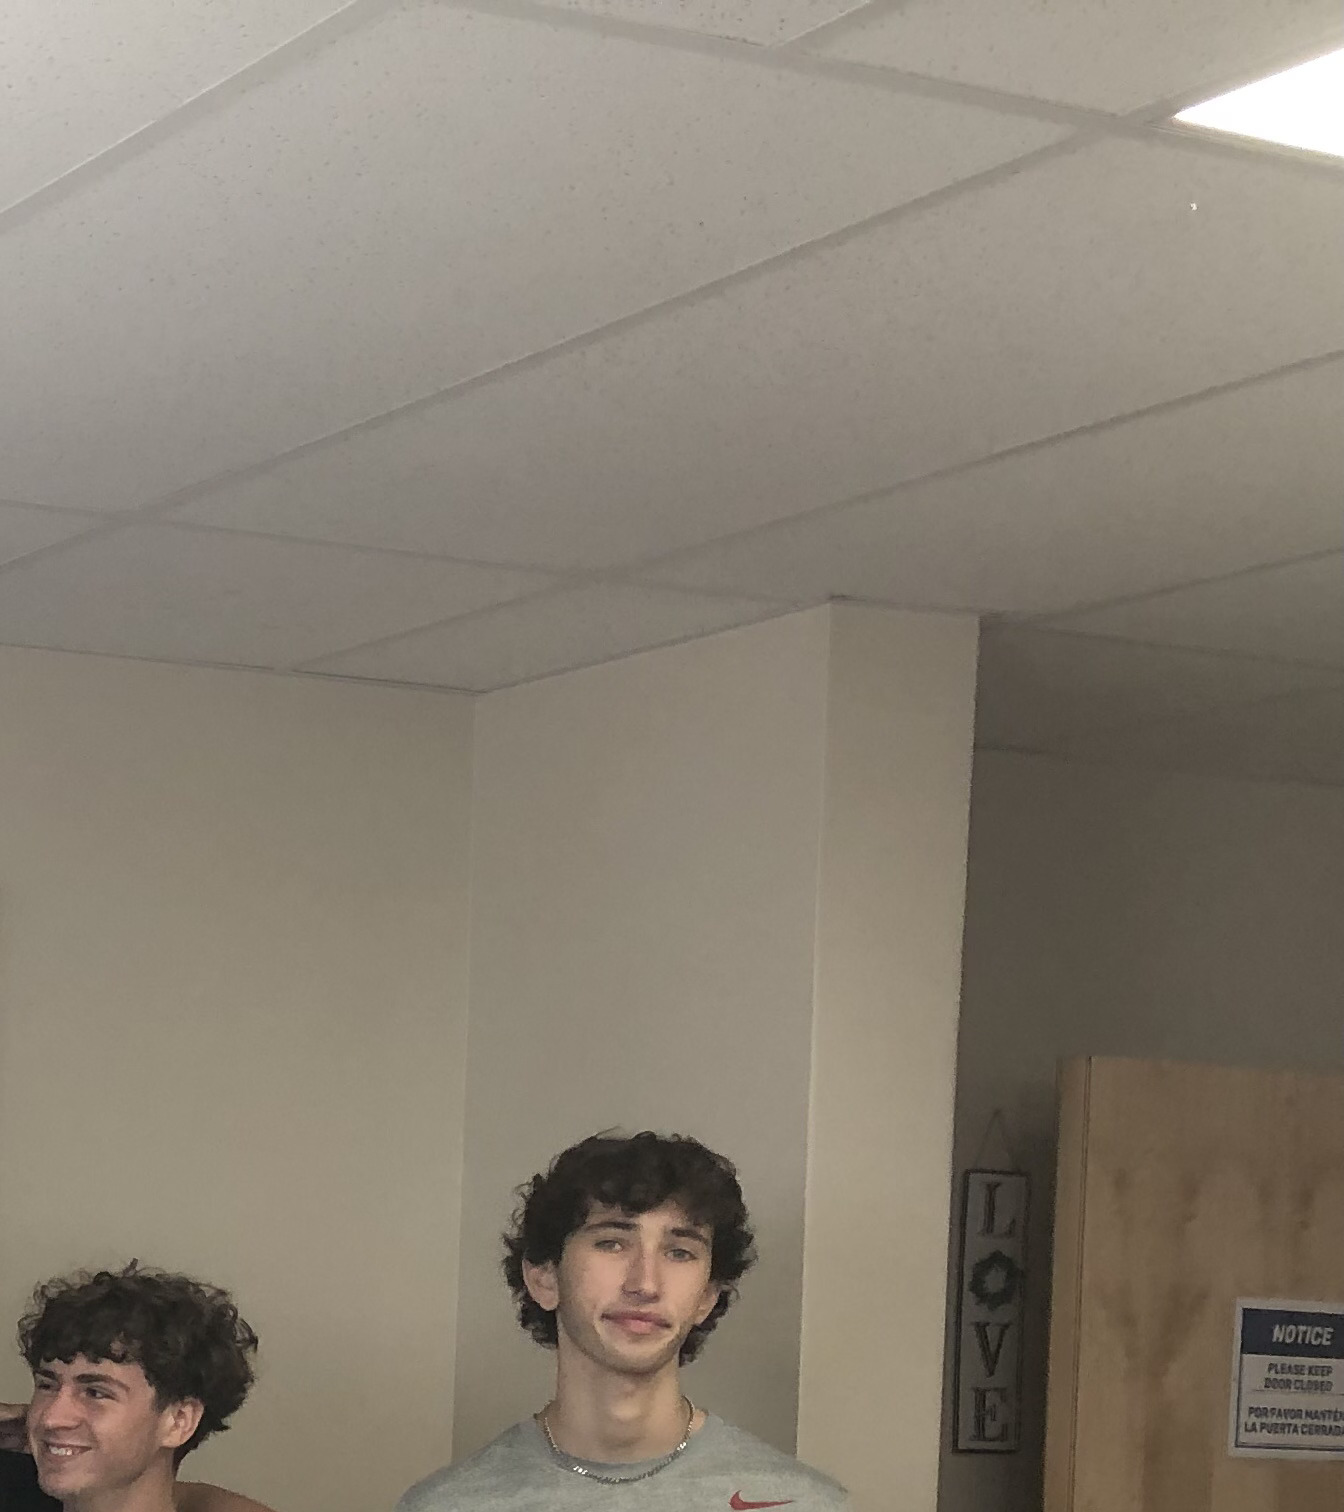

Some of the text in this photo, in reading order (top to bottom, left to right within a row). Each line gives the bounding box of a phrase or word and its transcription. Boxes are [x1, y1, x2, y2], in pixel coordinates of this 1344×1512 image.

[968, 1181, 1023, 1442] LOVE
[1272, 1324, 1334, 1346] NOTICE
[1268, 1362, 1333, 1377] PLEASE KEEP
[1264, 1377, 1333, 1392] DOOR CLOSED
[1248, 1406, 1268, 1419] POR
[1270, 1407, 1302, 1420] FAVOR
[1244, 1421, 1257, 1433] LA
[1260, 1422, 1298, 1435] PUERTA
